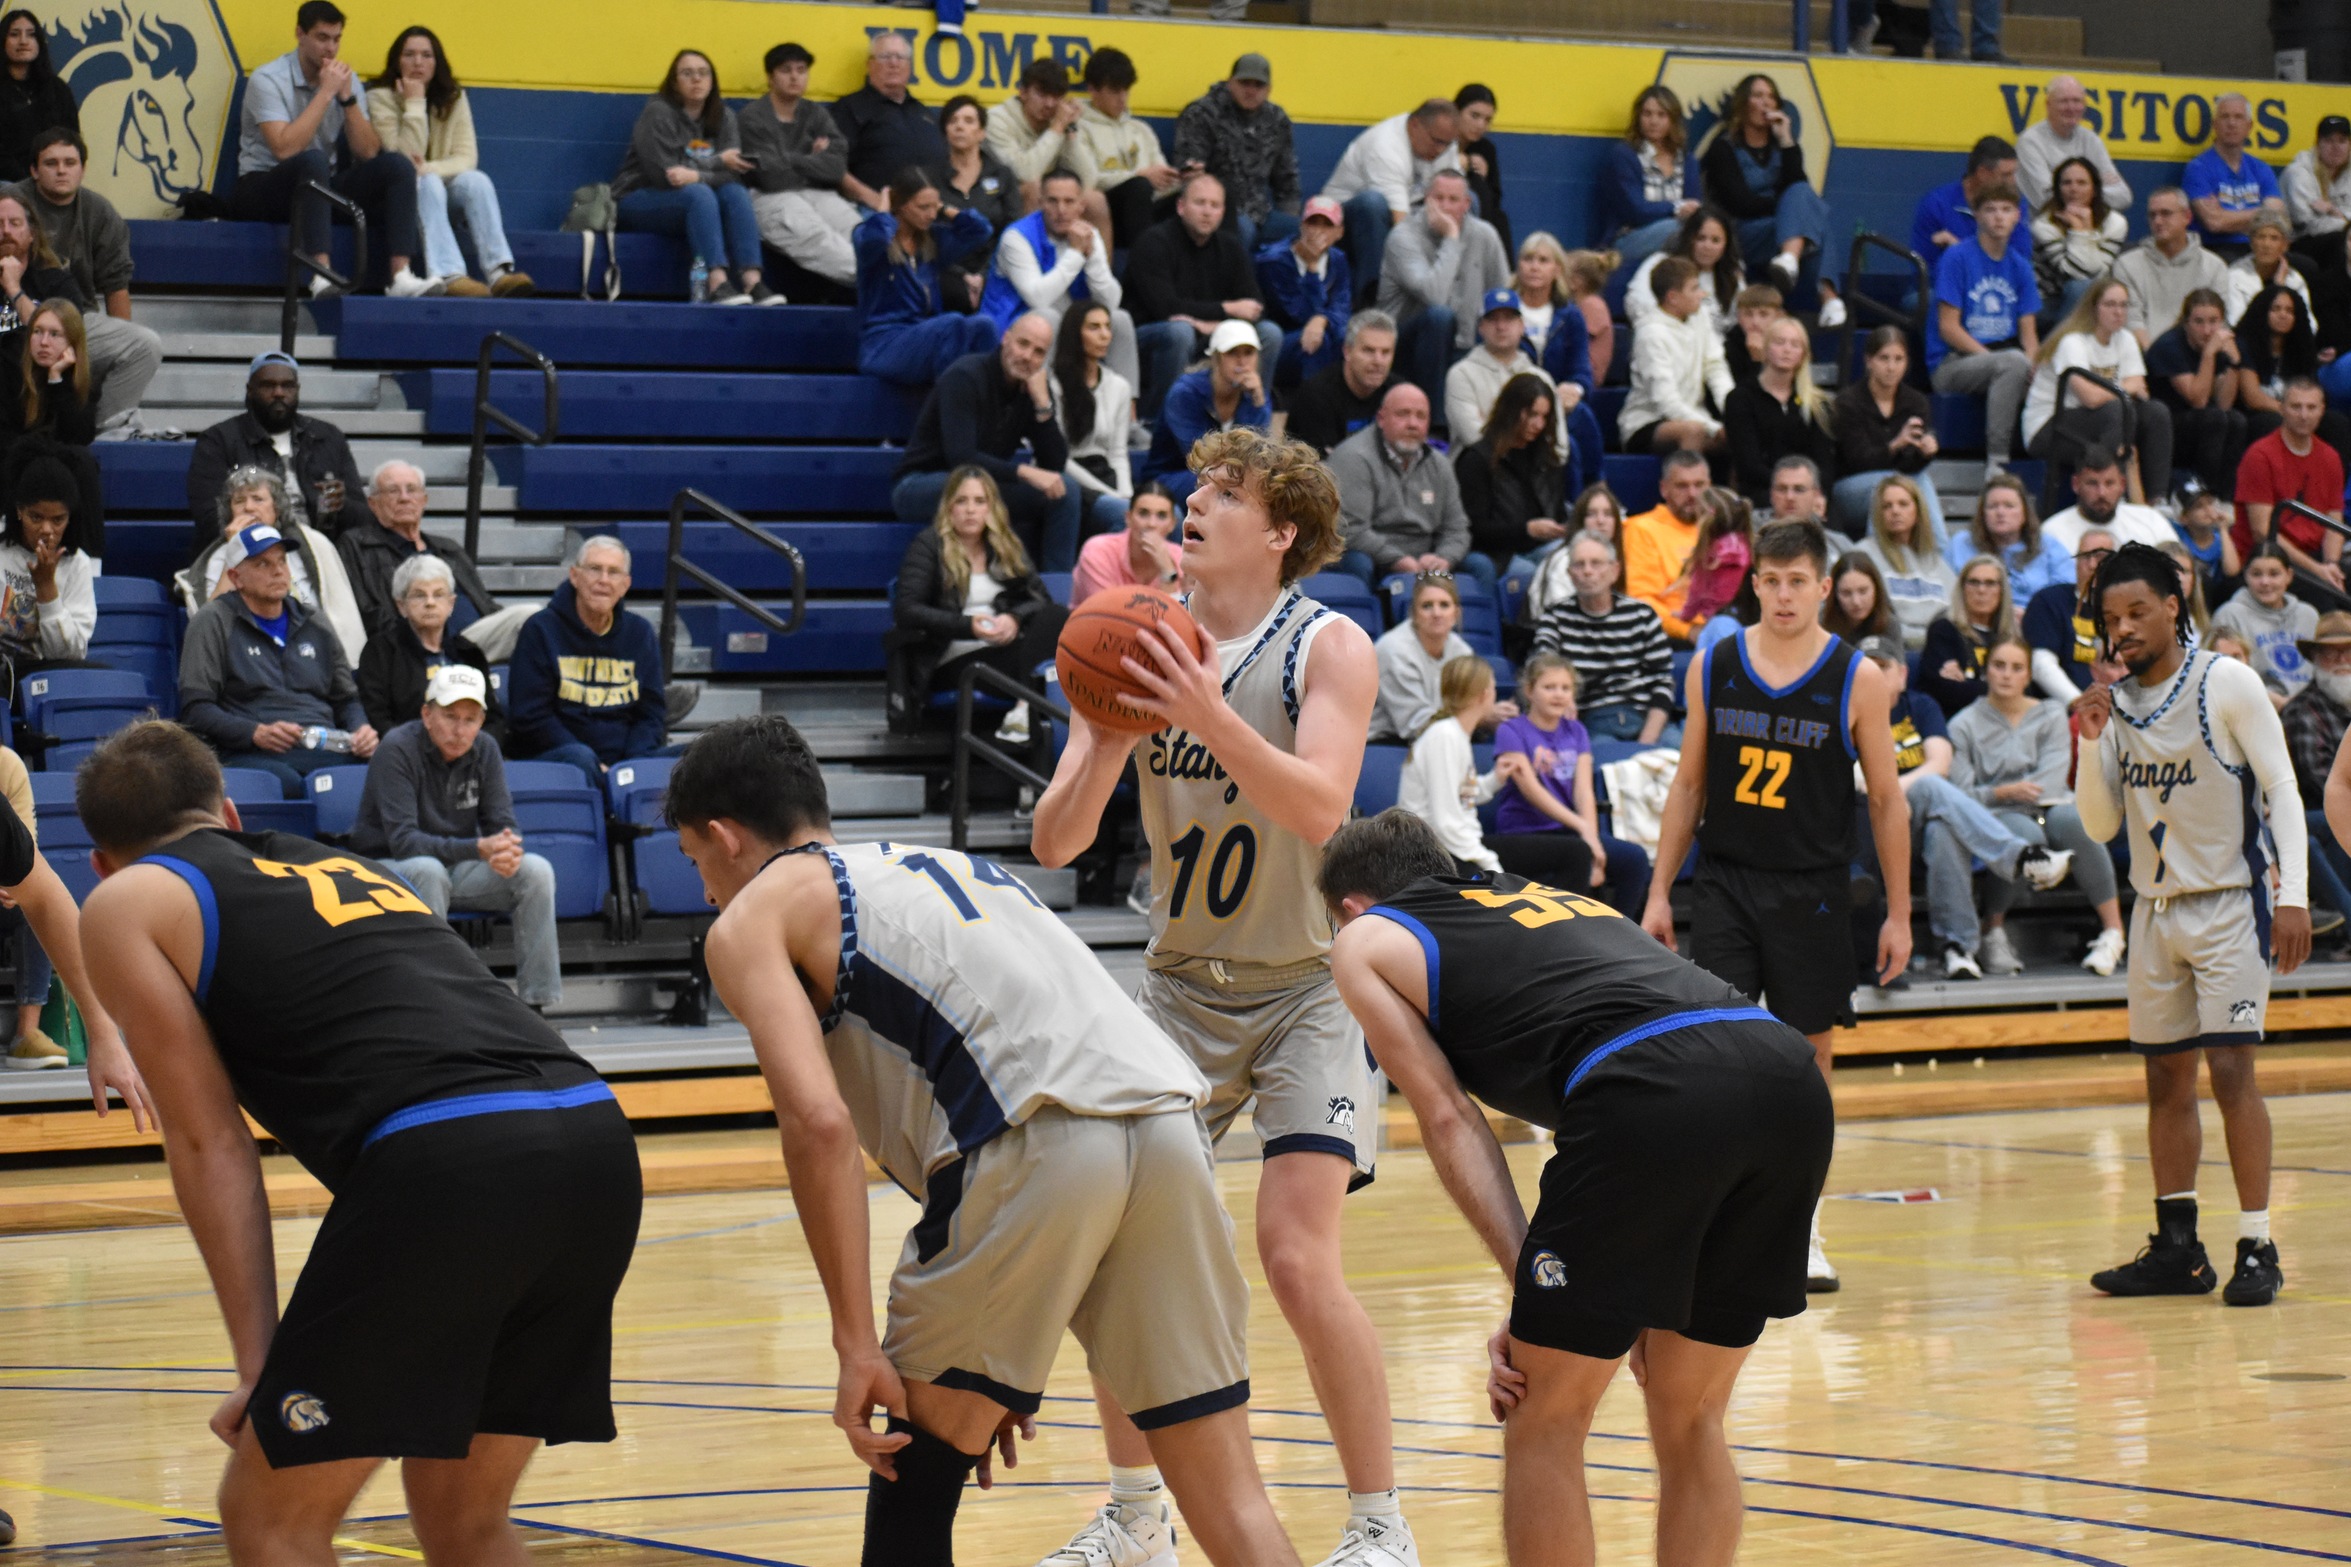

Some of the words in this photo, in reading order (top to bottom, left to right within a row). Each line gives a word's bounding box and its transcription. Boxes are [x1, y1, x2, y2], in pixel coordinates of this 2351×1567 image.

[2000, 84, 2290, 150] VSITOS
[1149, 724, 1240, 805] Stan
[1774, 714, 1830, 749] CLIFF
[1734, 745, 1793, 810] 22
[2120, 751, 2198, 804] tangs
[1161, 818, 1262, 923] 10
[2147, 816, 2172, 887] 1
[252, 856, 433, 928] 23
[884, 850, 1047, 928] 14
